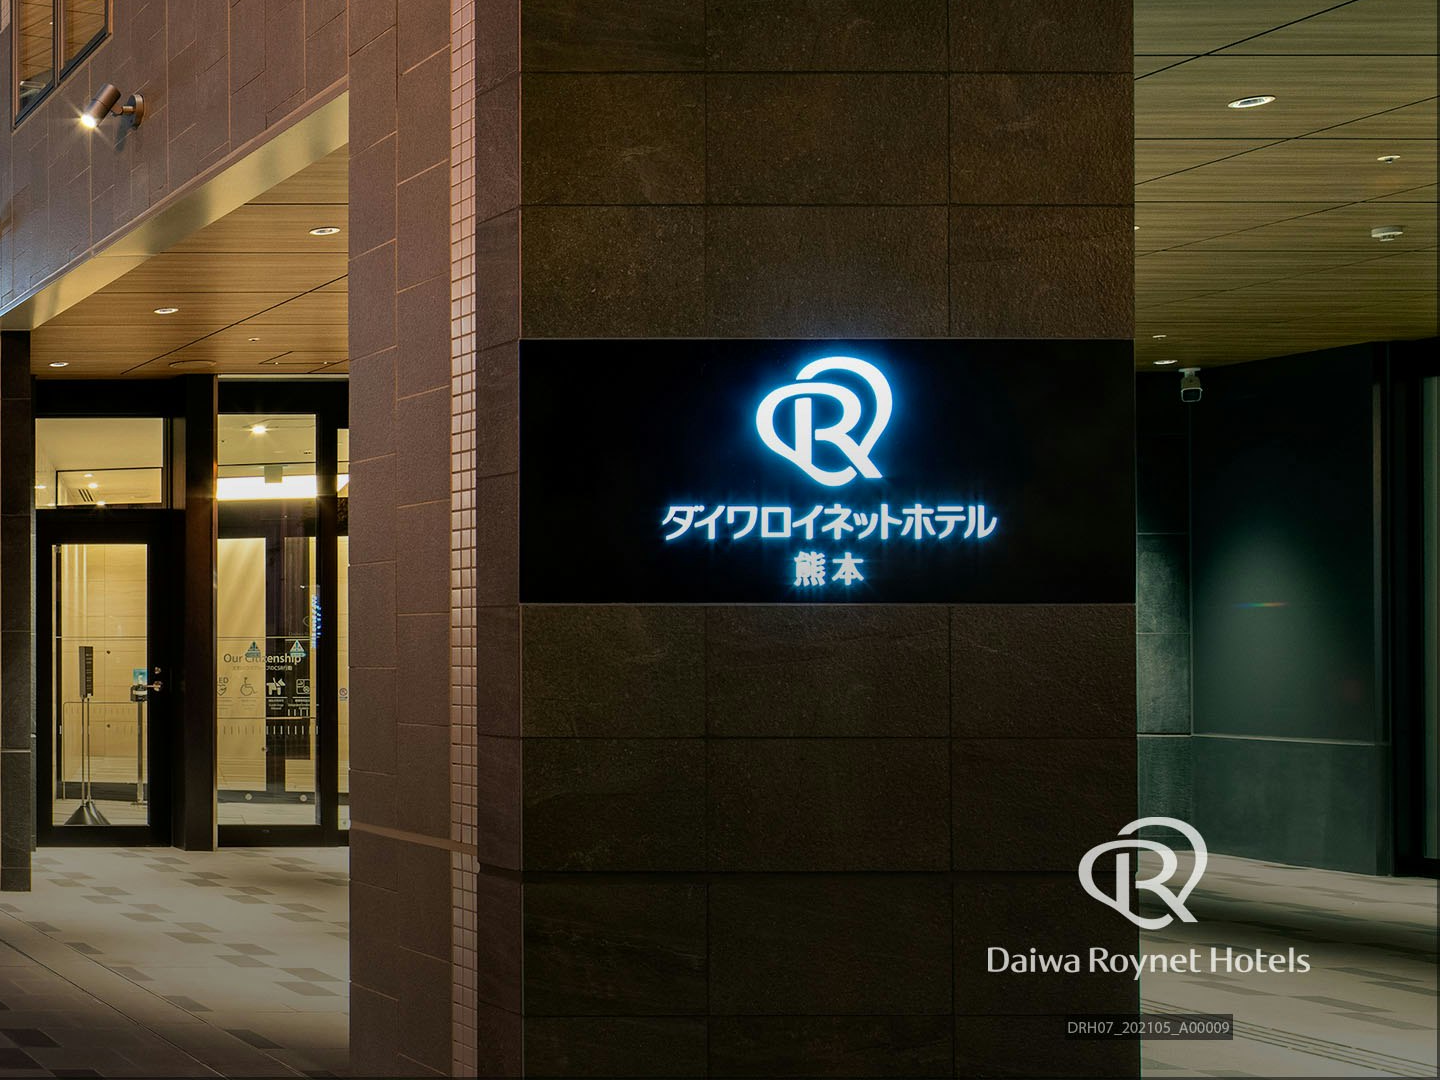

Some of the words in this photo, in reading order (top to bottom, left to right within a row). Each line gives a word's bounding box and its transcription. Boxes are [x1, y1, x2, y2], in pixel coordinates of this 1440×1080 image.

[662, 503, 998, 541] ダイワロイネットホテル
[793, 551, 864, 587] 熊本
[224, 653, 242, 663] Our
[217, 676, 229, 684] ED
